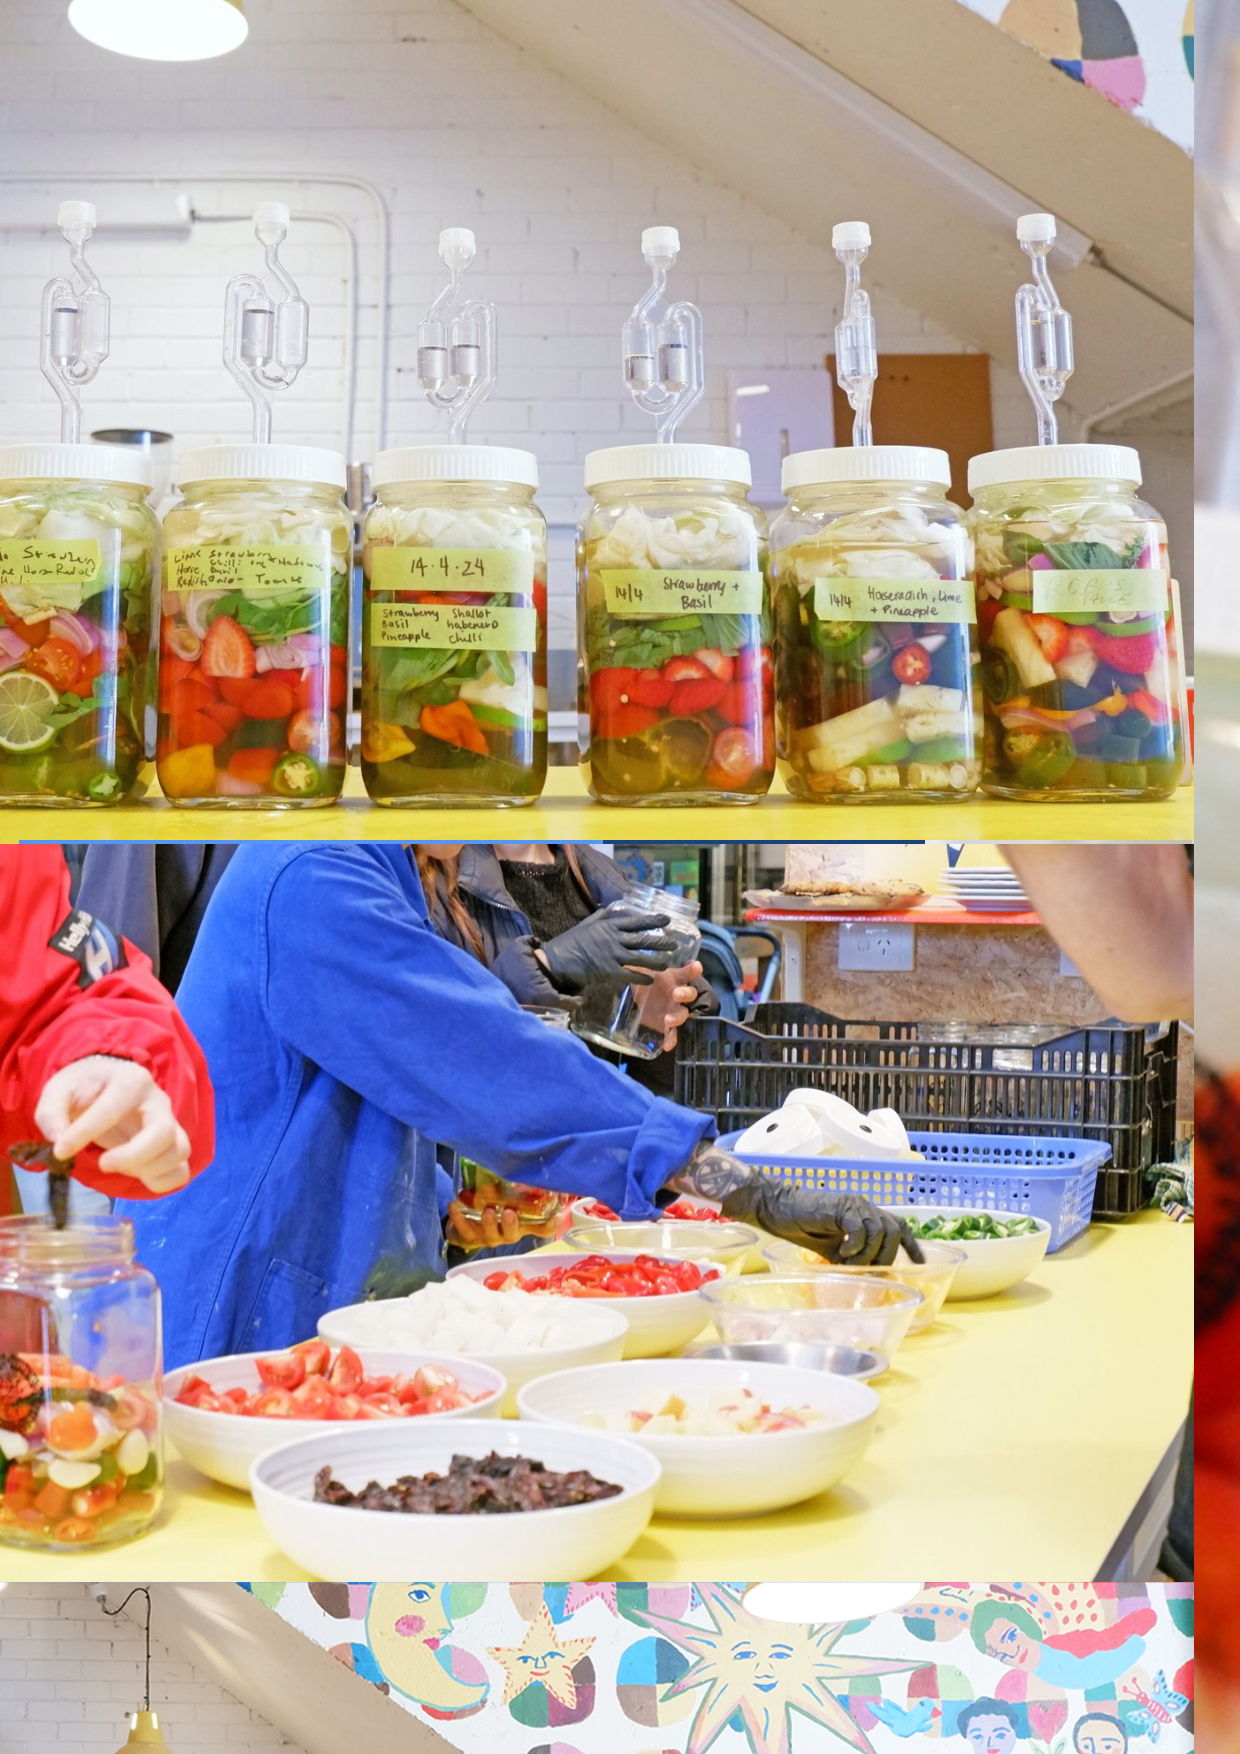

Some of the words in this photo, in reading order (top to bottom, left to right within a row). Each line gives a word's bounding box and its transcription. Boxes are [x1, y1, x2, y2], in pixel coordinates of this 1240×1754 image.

[615, 583, 643, 603] 14/4
[663, 576, 726, 596] Strawberry
[681, 594, 713, 610] Basil
[938, 590, 963, 605] Lime
[383, 607, 440, 622] Strawberry
[453, 608, 491, 619] Shallot
[882, 604, 939, 618] Pineapple
[382, 619, 409, 629] Basil
[382, 628, 431, 643] Pineapple
